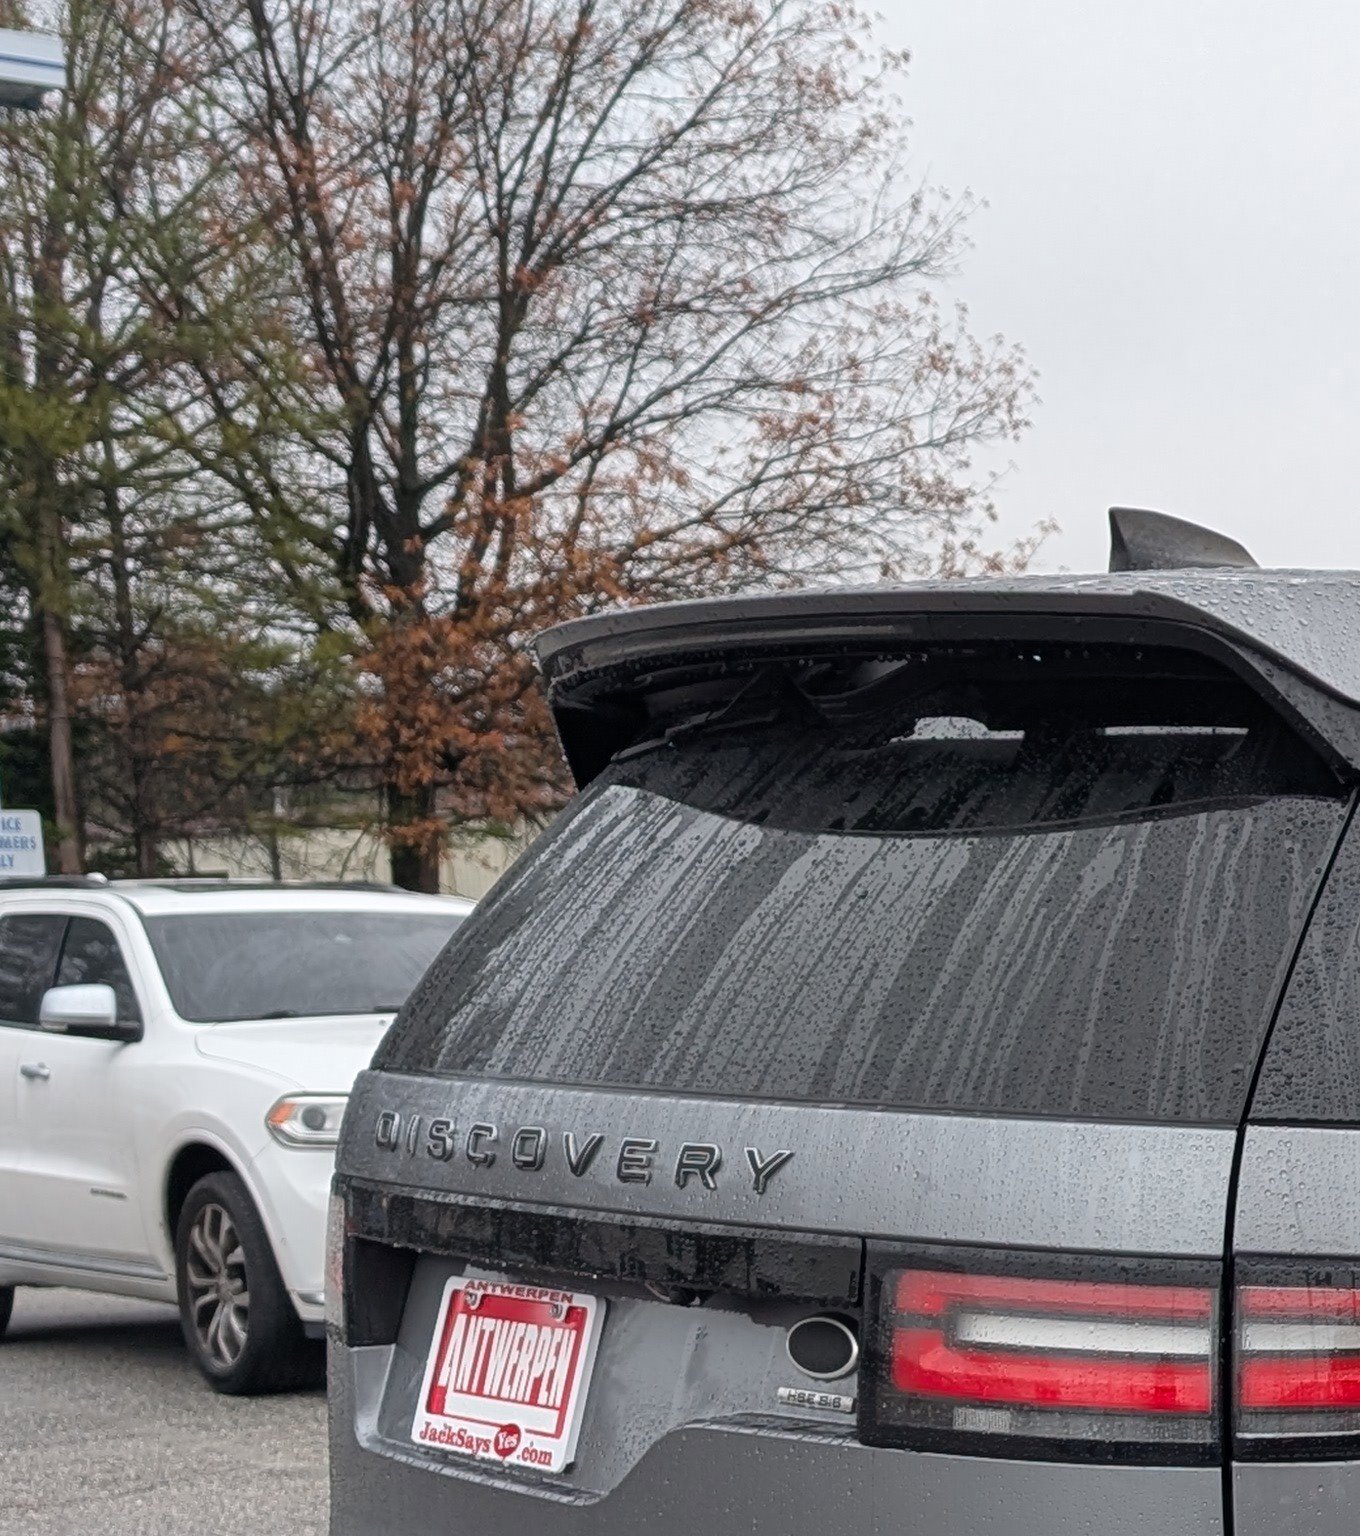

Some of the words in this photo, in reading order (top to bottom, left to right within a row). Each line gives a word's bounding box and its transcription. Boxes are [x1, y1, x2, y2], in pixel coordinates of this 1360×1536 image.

[374, 1109, 795, 1195] DISCOVERY
[464, 1279, 575, 1304] ANTWERPEN
[437, 1313, 577, 1408] ANTWERPEN
